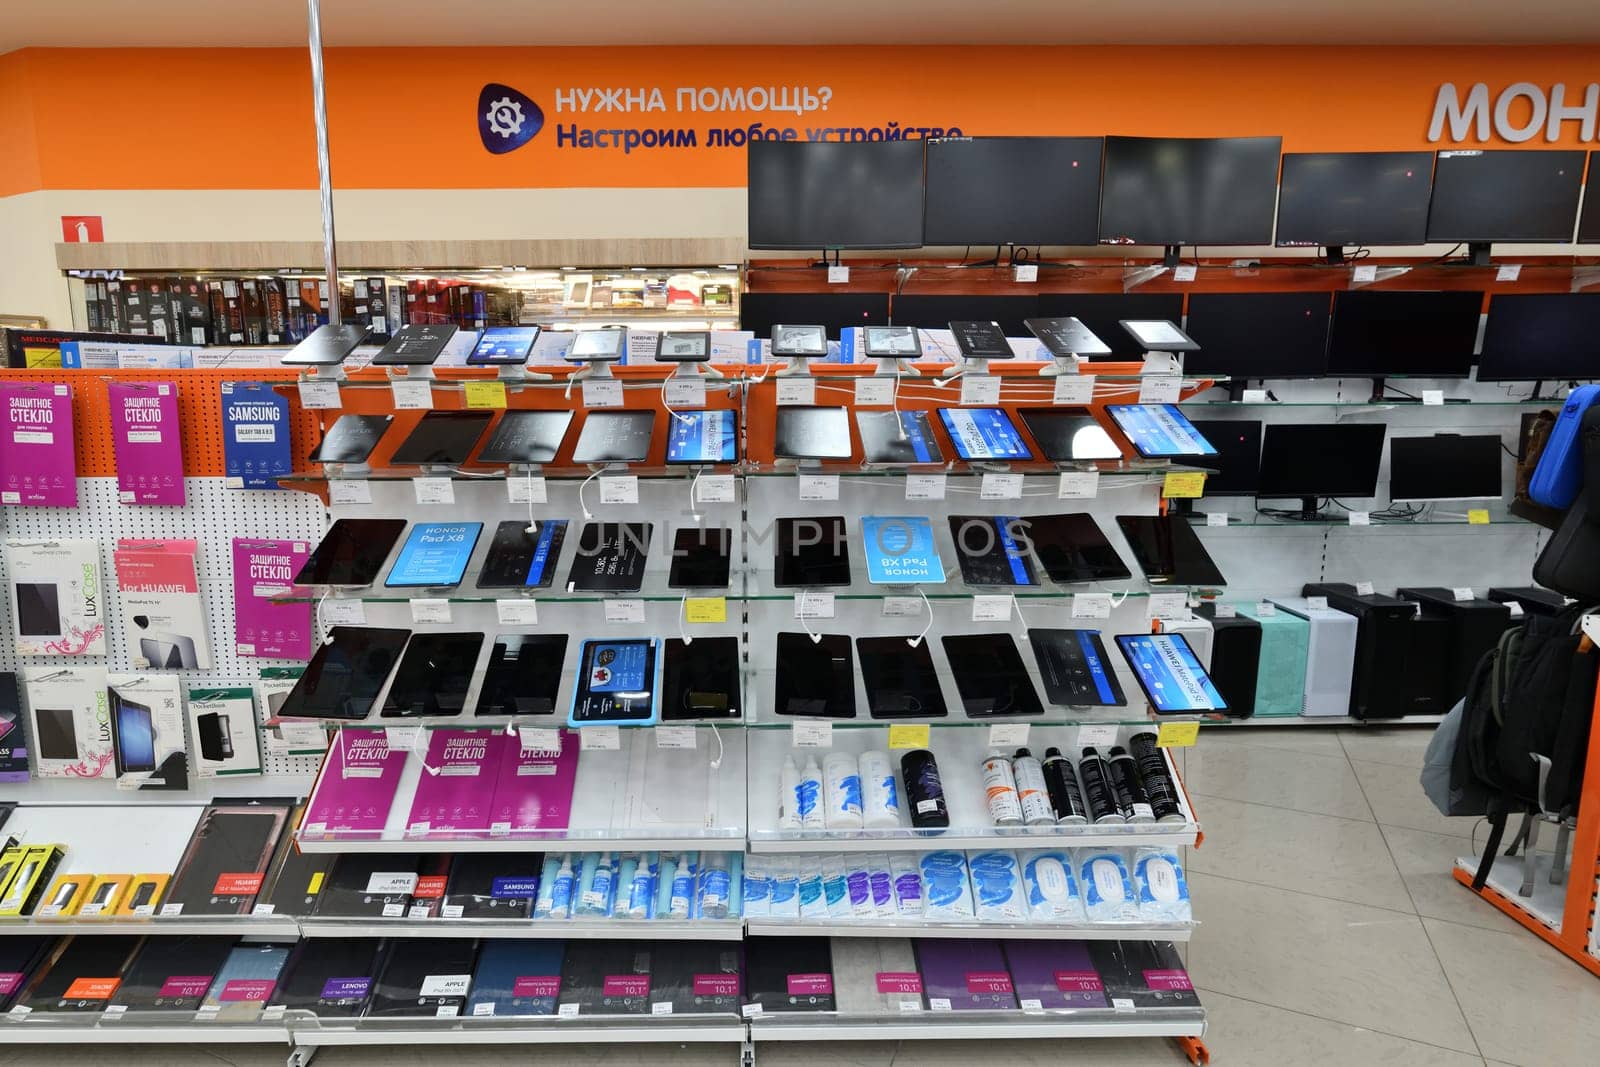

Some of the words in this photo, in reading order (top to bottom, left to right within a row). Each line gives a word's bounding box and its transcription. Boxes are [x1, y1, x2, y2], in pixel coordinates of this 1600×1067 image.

[555, 87, 667, 113] НУЖНА
[677, 86, 833, 116] ПОМОЩЬ?
[1427, 82, 1600, 142] МОН
[557, 123, 697, 154] Настроим
[706, 122, 797, 147] любое
[9, 398, 52, 409] ЗАЩИТНОЕ
[124, 398, 161, 408] ЗАЩИТНОЕ
[10, 409, 53, 424] СТЕКЛО
[125, 408, 161, 423] СТЕКЛО
[228, 407, 280, 421] SAMSUNG
[420, 534, 444, 543] Pad
[446, 535, 465, 543] X8
[250, 554, 291, 566] ЗАЩИТНОЕ
[880, 559, 900, 567] X8
[903, 558, 928, 566] Pad
[250, 565, 292, 580] СТЕКЛО
[885, 568, 929, 576] HONOR
[123, 583, 139, 593] for
[141, 583, 186, 593] HUAWEI
[1159, 640, 1181, 669] HUAWEI
[352, 739, 389, 748] ЗАЩИТНО
[447, 739, 487, 748] ЗАЩИТНОЕ
[347, 748, 390, 760] СТЕКЛО
[443, 748, 486, 760] СТЕКЛО
[519, 750, 561, 760] СТЕКЛО
